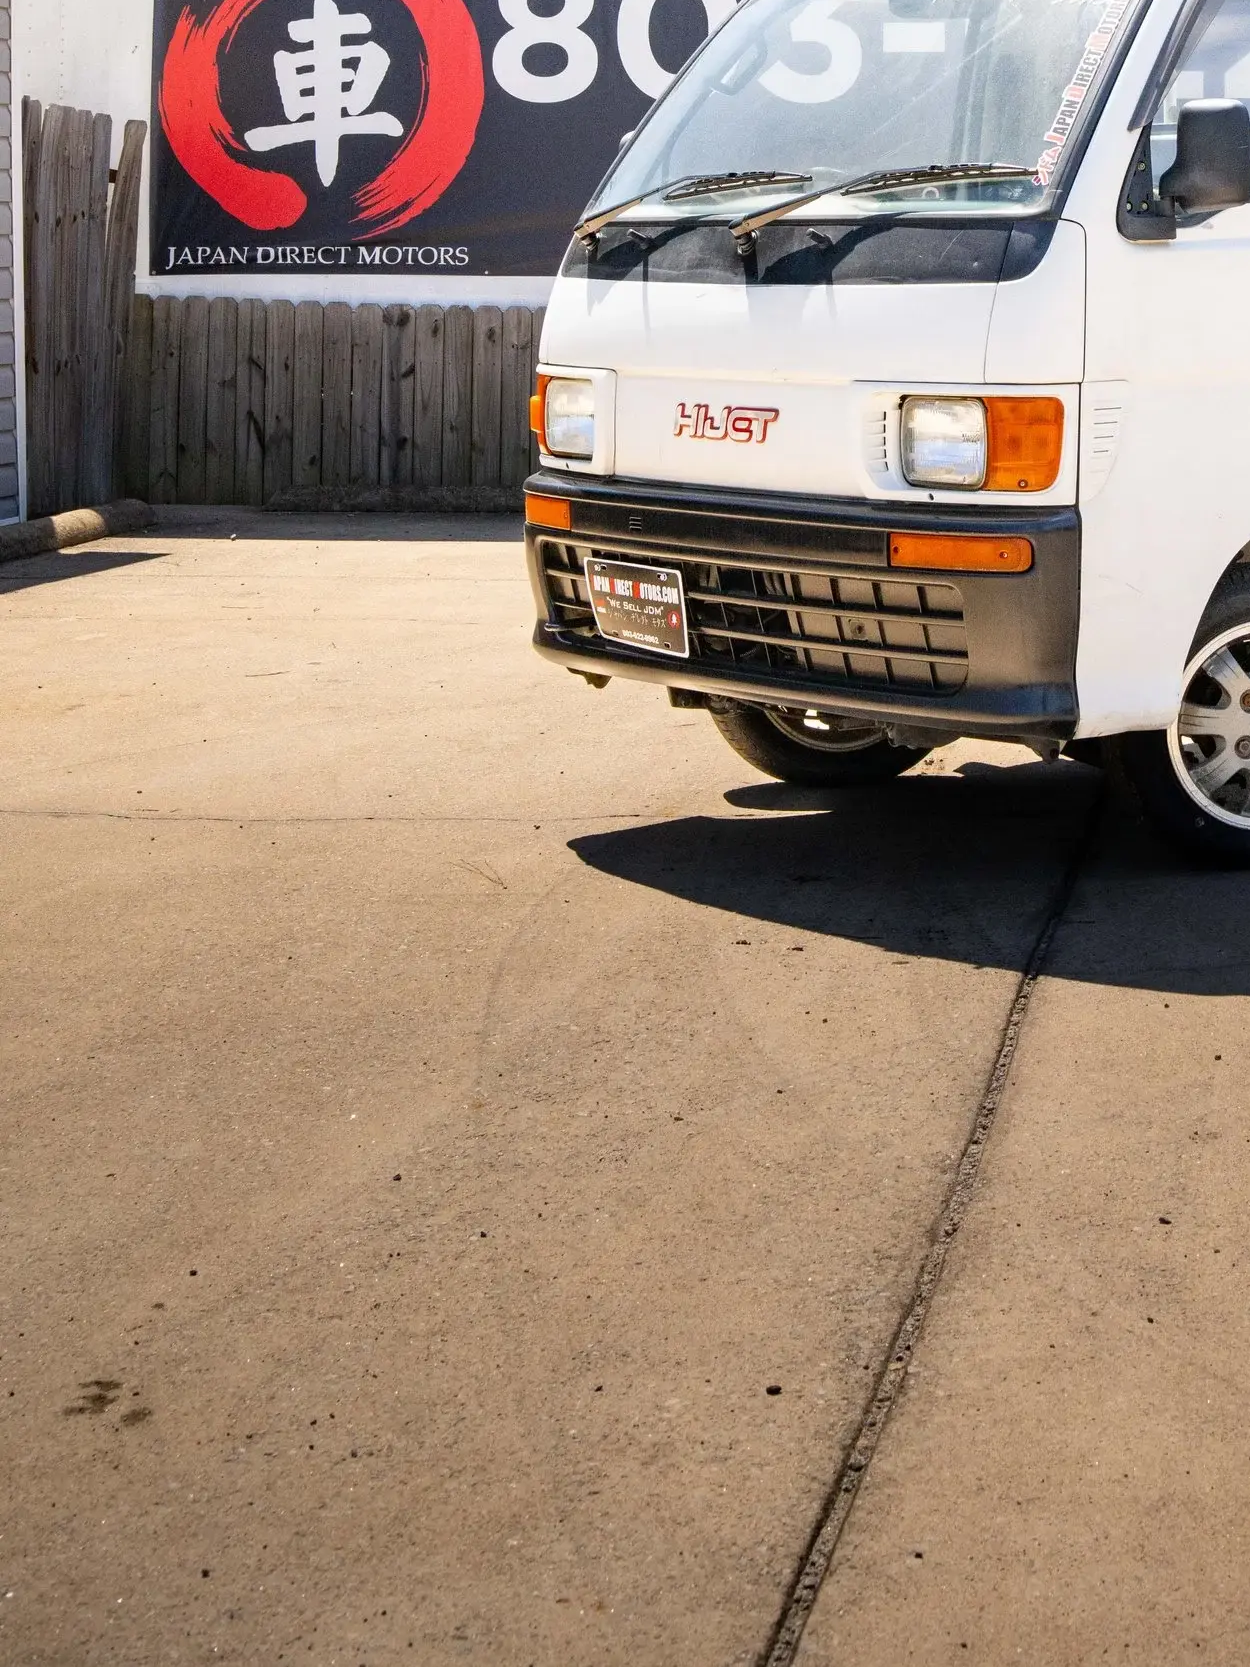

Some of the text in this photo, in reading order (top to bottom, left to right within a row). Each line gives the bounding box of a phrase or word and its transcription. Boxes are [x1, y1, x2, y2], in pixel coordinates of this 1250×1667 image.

[166, 246, 469, 269] JAPAN DIRECT MOTORS
[674, 402, 779, 443] HIJET
